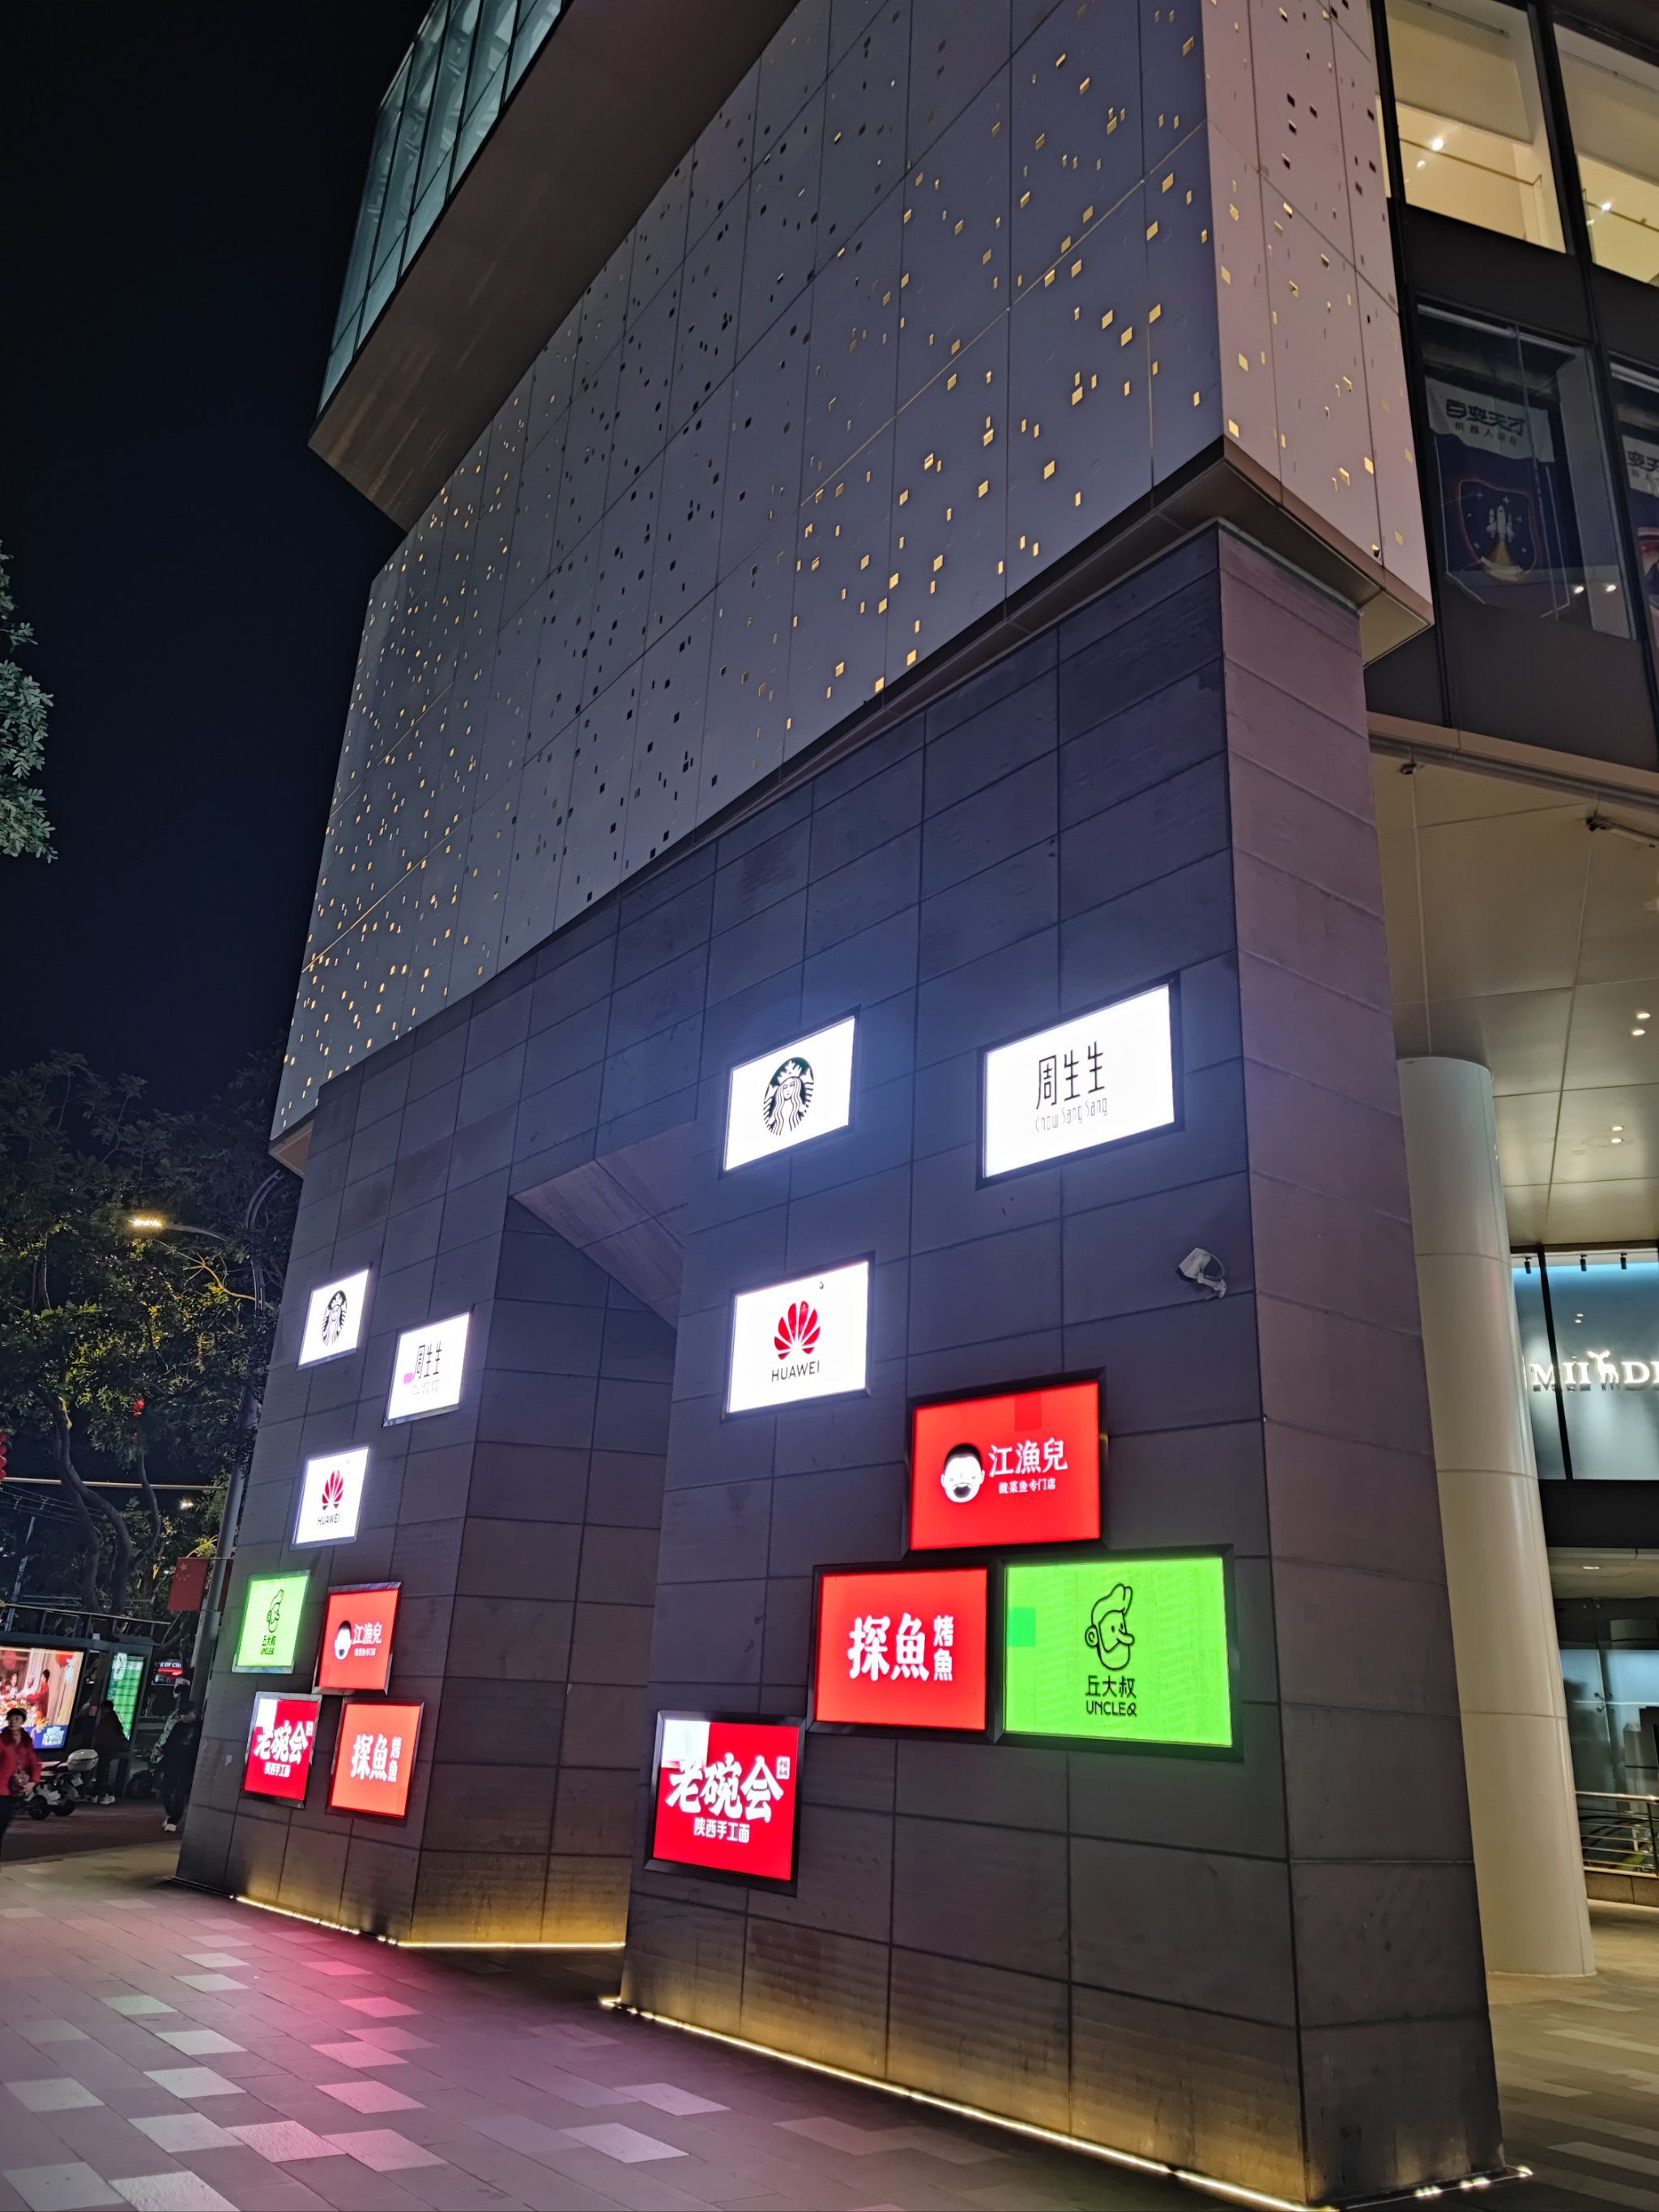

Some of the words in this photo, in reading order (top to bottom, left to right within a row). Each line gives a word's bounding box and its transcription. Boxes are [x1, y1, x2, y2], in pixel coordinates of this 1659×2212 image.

[1036, 1041, 1105, 1110] 周生生
[413, 1340, 442, 1379] 周生生
[771, 1360, 820, 1383] HUAWEI
[988, 1437, 1068, 1478] 江漁兒
[318, 1513, 341, 1526] HUAWEI
[847, 1612, 930, 1682] 探魚
[1085, 1675, 1137, 1699] 丘大叔
[253, 1720, 309, 1765] 老碗会
[350, 1733, 388, 1782] 探魚
[665, 1752, 784, 1823] 老碗会
[693, 1817, 750, 1843] 陕西手工面
